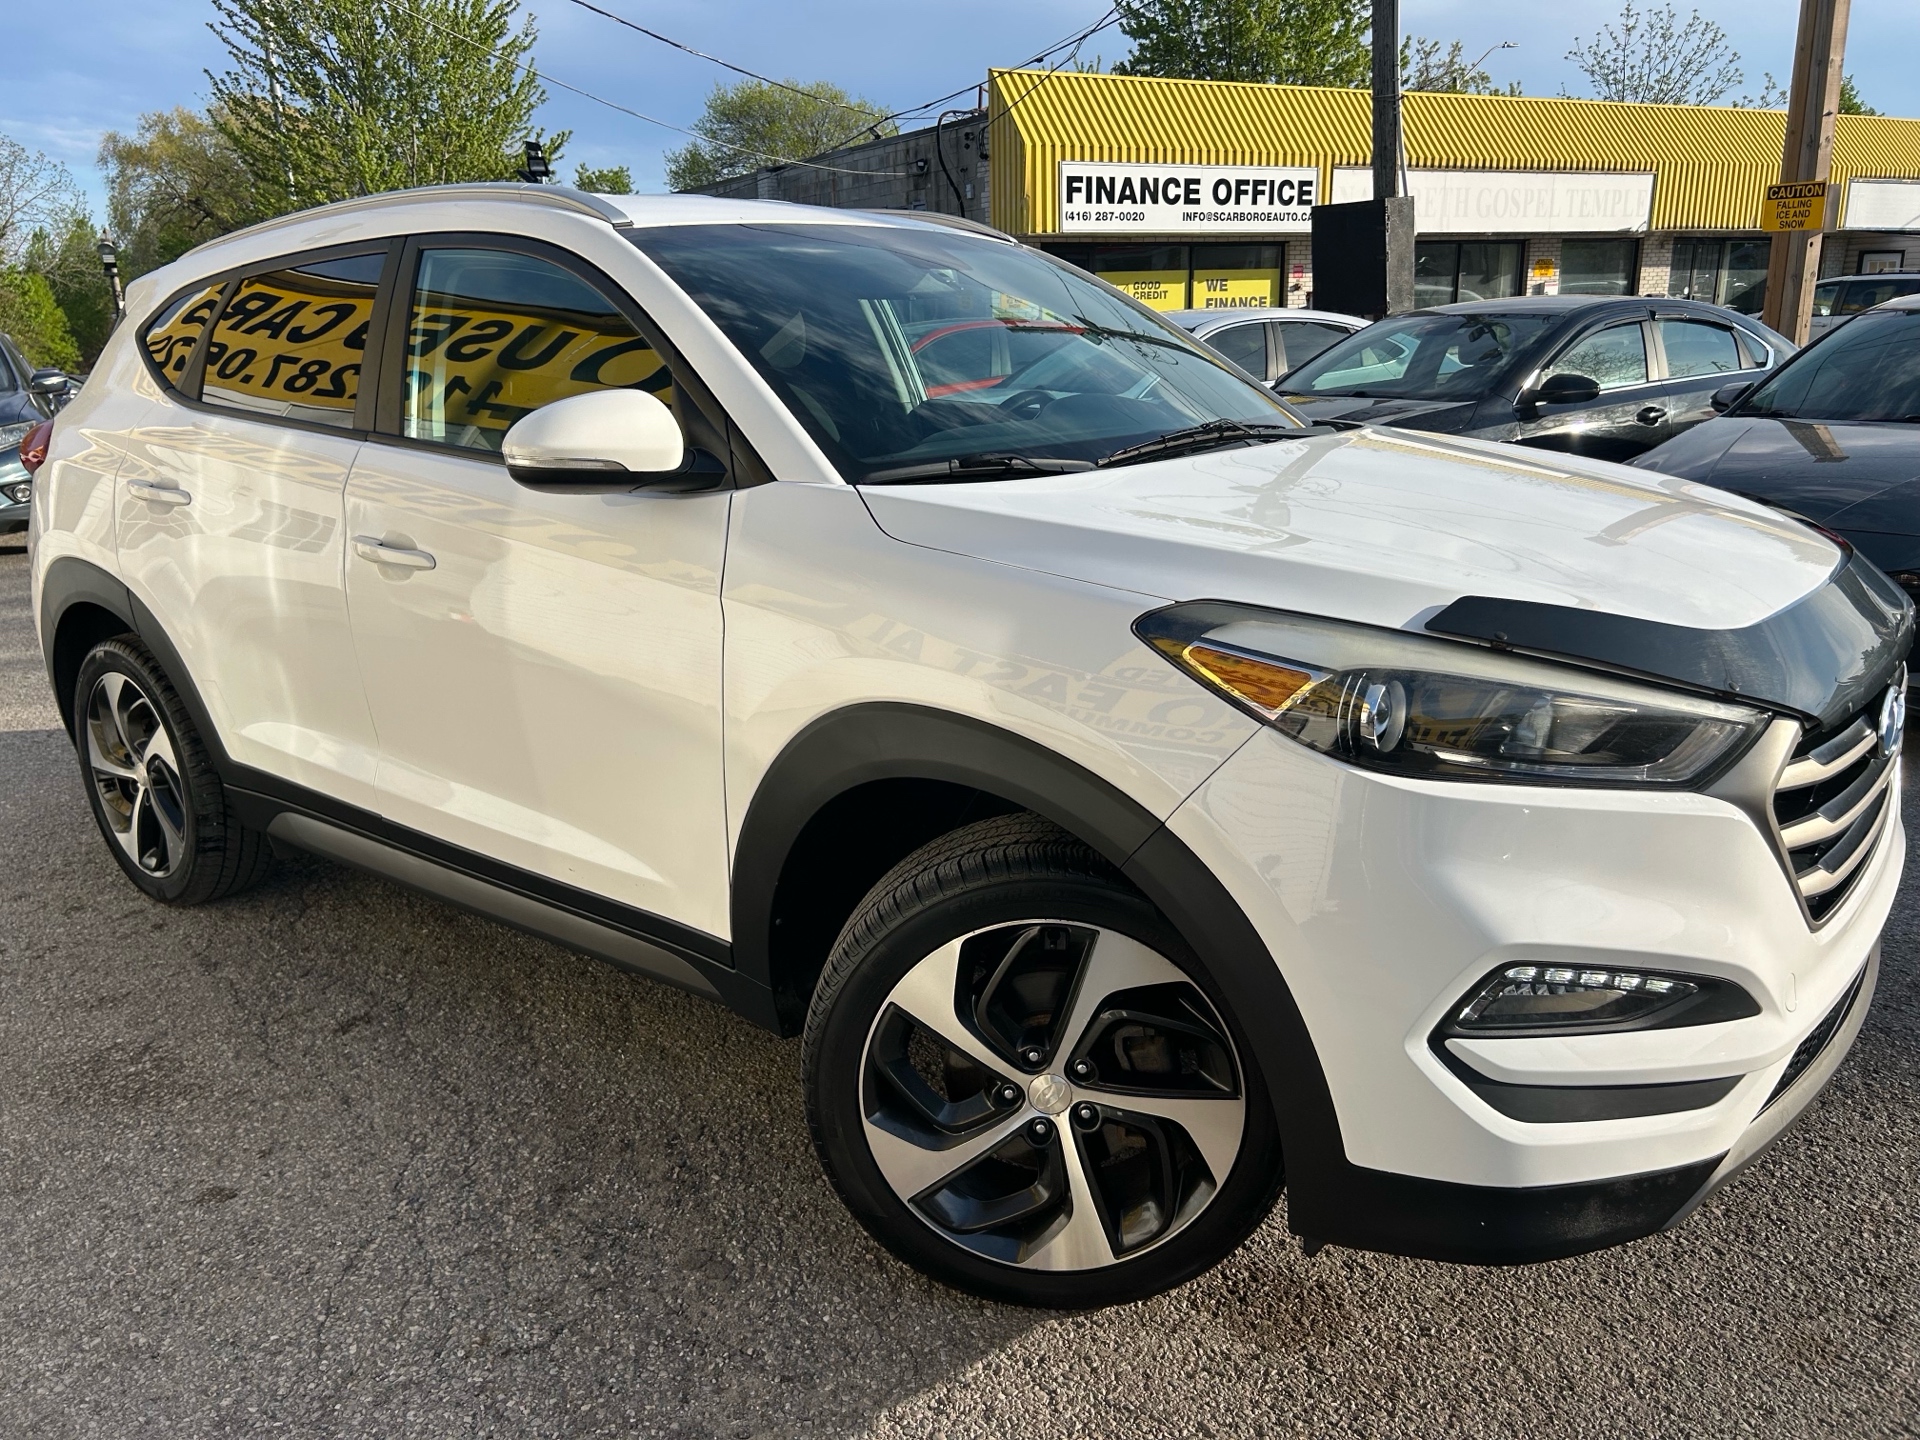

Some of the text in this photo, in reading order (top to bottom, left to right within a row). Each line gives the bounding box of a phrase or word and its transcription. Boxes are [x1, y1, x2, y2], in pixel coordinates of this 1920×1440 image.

[1065, 175, 1314, 207] FINANCE OFFICE
[1769, 184, 1824, 199] CAUTION
[1475, 186, 1561, 219] GOSPEL
[1566, 188, 1648, 219] TEMPLE
[1776, 199, 1812, 210] FALLING
[1065, 211, 1092, 222] (416)
[1094, 211, 1146, 222] 287-0020
[1775, 209, 1811, 220] ICE AND
[1778, 219, 1806, 230] SNOW
[1132, 281, 1161, 291] GOOD
[1205, 278, 1228, 292] WE
[1132, 290, 1169, 300] CREDIT
[1205, 296, 1268, 308] FINANCE
